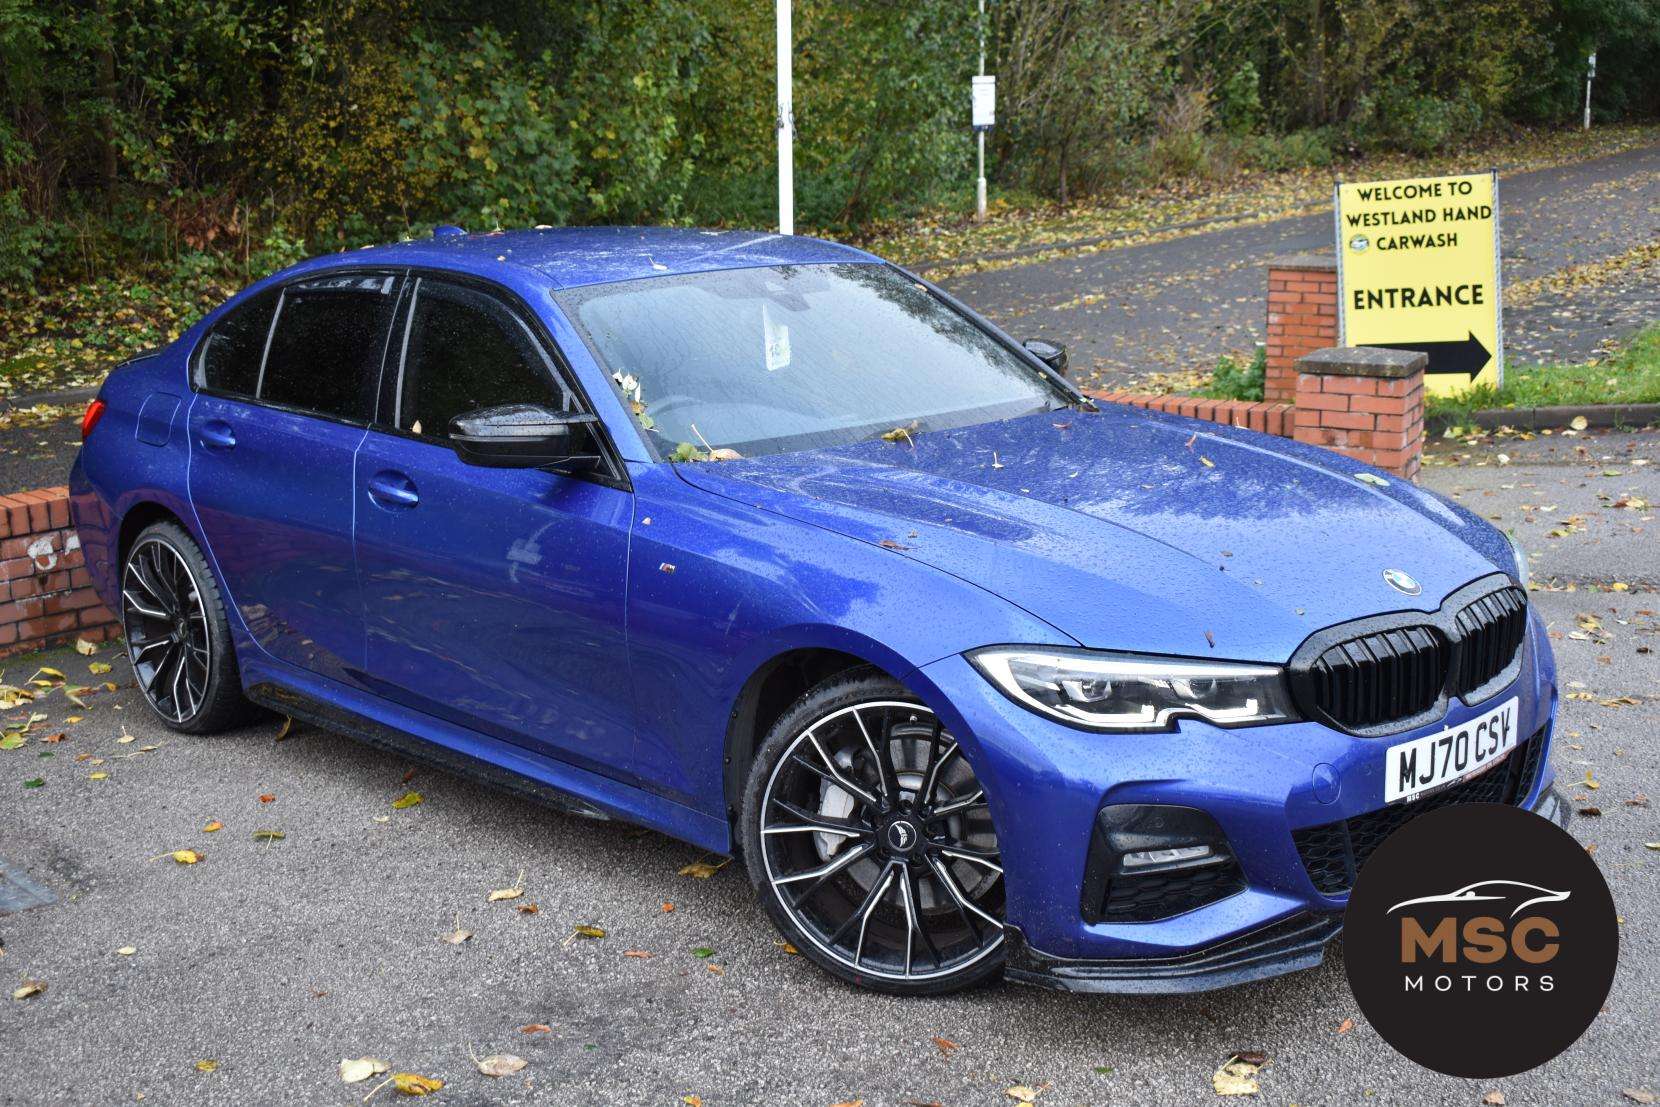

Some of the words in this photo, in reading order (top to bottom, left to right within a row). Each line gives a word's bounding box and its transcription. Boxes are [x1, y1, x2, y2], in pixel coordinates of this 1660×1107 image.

[1358, 184, 1442, 201] WELCOME
[1448, 181, 1473, 196] TO
[1346, 209, 1436, 227] WESTLAND
[1443, 205, 1492, 222] HAND
[1376, 233, 1458, 251] CARWASH
[1354, 284, 1484, 310] ENTRANCE
[1399, 730, 1469, 793] MJ70
[1475, 706, 1511, 762] CSV
